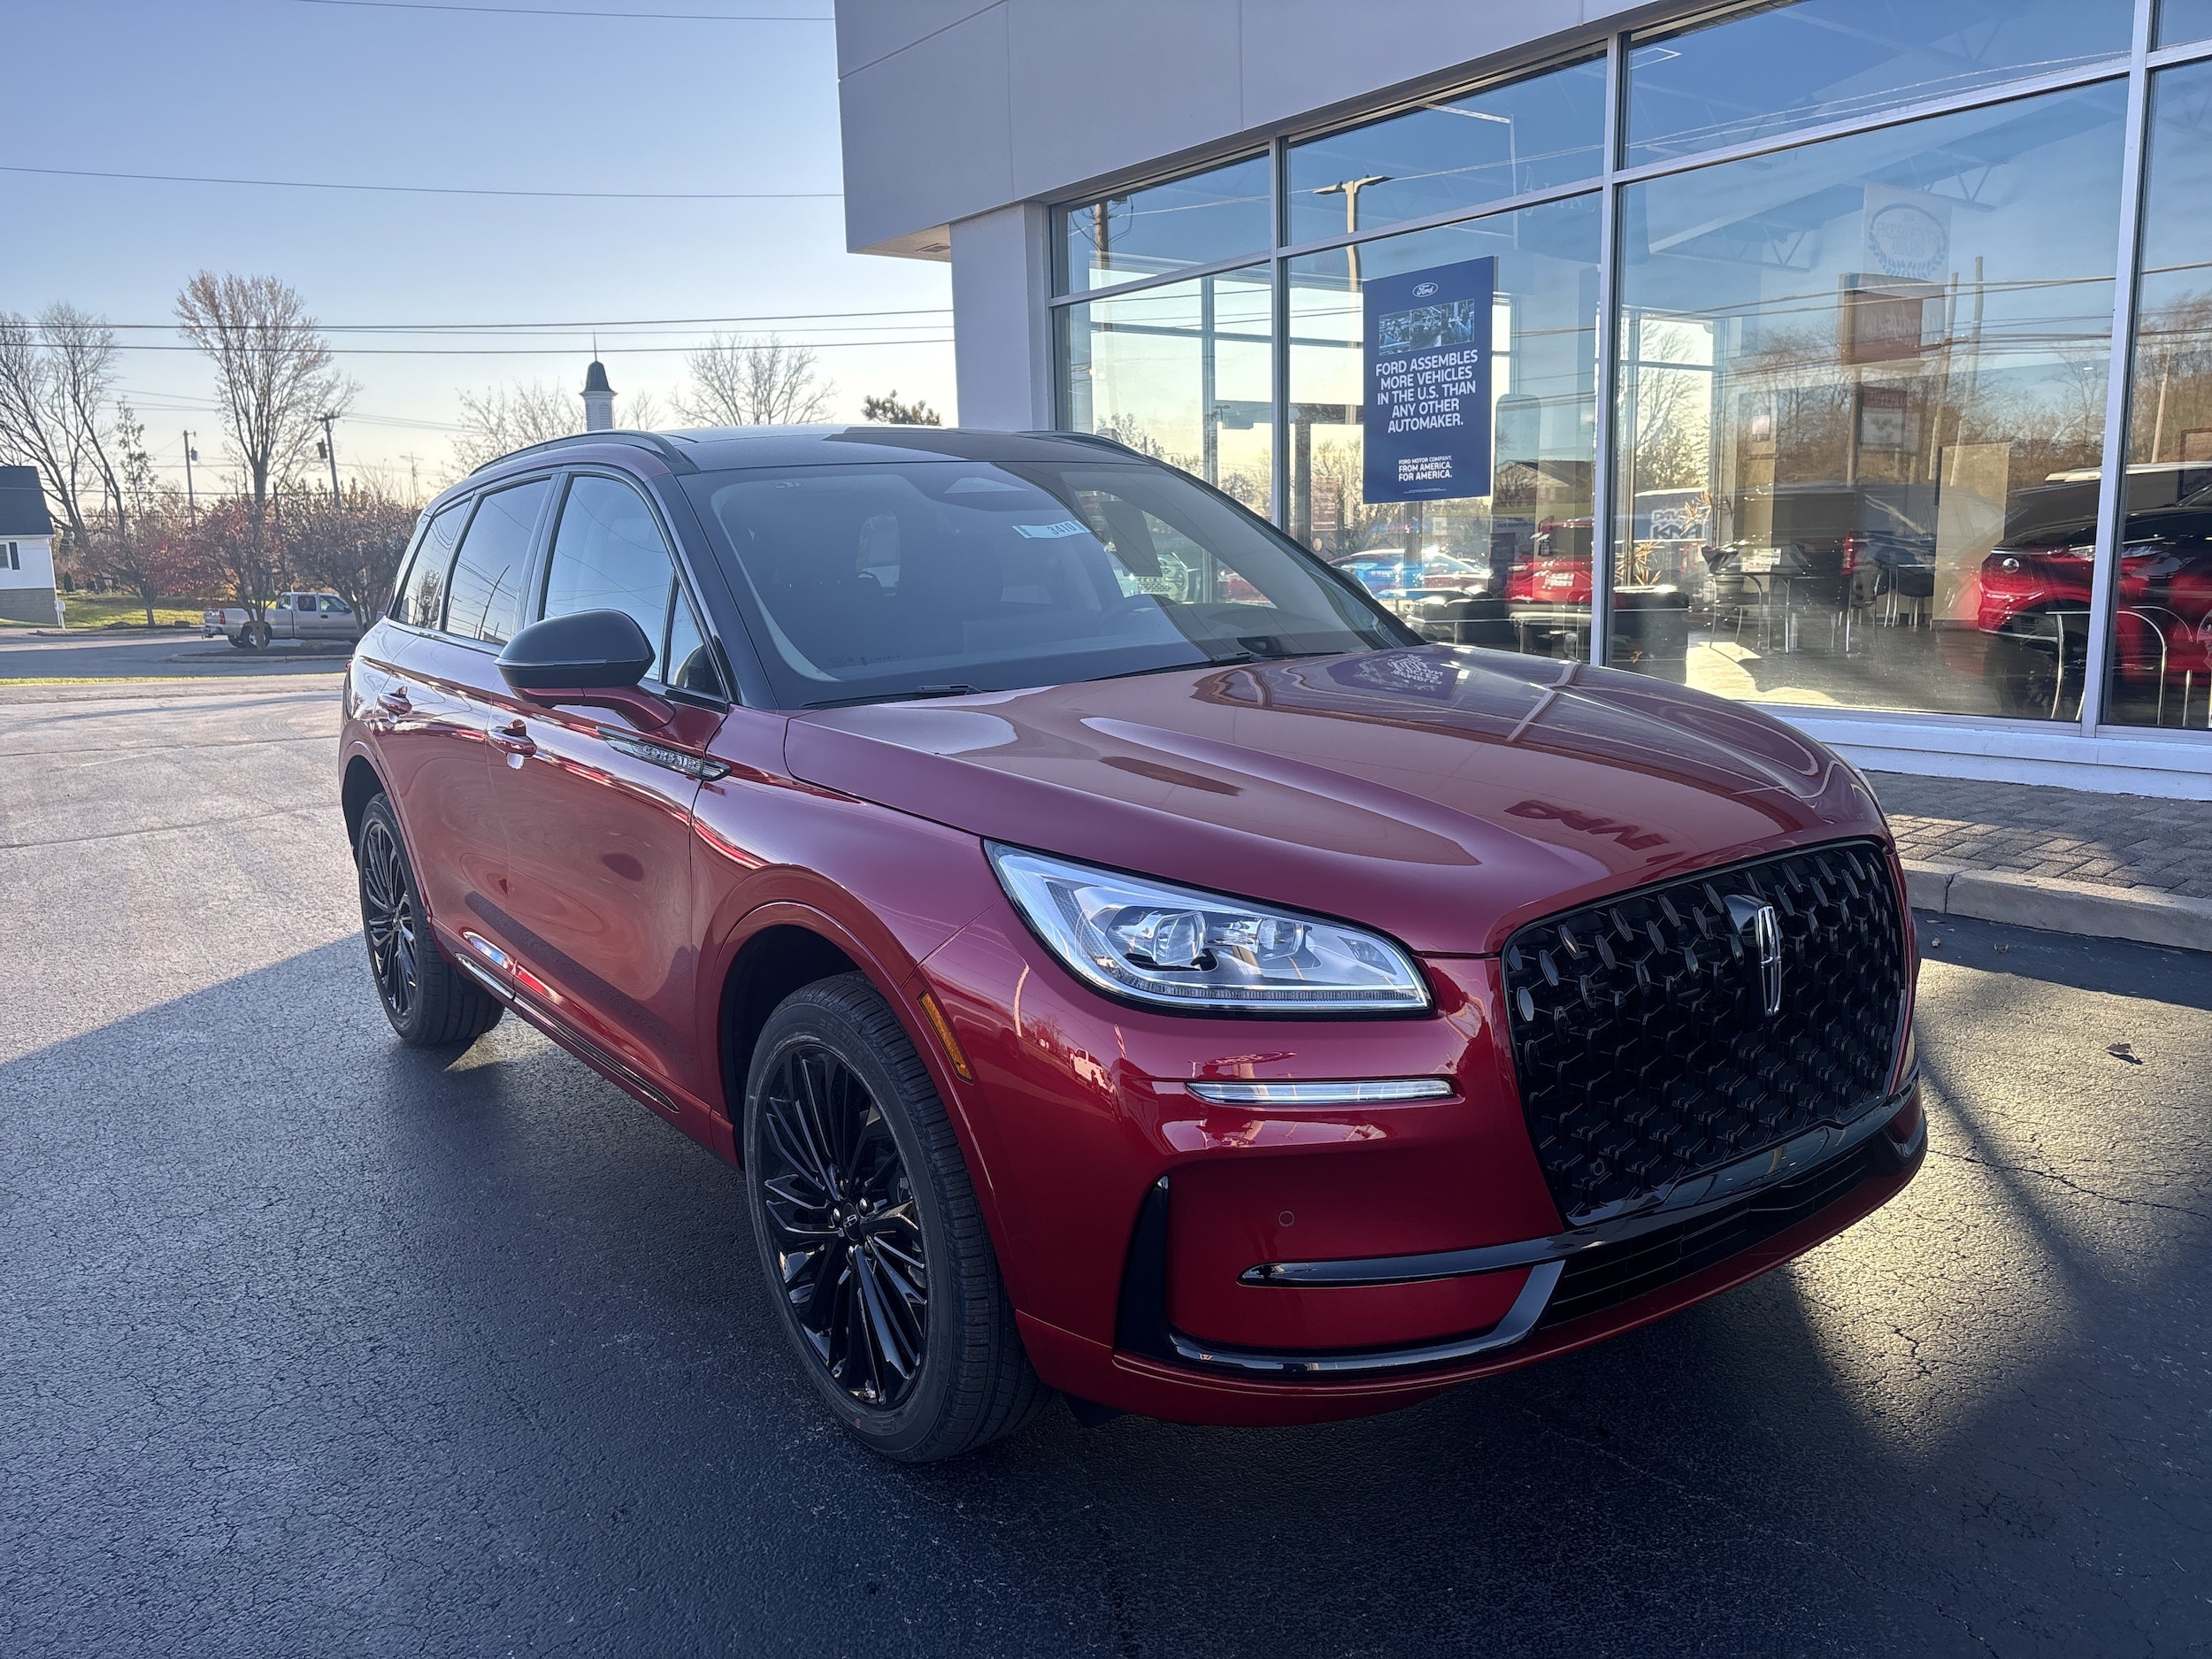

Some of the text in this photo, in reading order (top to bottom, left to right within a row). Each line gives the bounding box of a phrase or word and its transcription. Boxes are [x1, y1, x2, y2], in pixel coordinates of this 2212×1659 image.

[1376, 349, 1479, 377] FORD ASSEMBLES
[1380, 365, 1472, 390] MORE VEHICLES
[1378, 380, 1476, 405] IN THE U.S. THAN
[1392, 397, 1459, 419] ANY OTHER
[1387, 413, 1463, 434] AUTOMAKER.
[1398, 461, 1453, 473] FROM AMERICA.
[1398, 469, 1453, 482] FOR AMERICA.
[1047, 522, 1078, 535] 3410
[642, 744, 697, 770] CORSAIR
